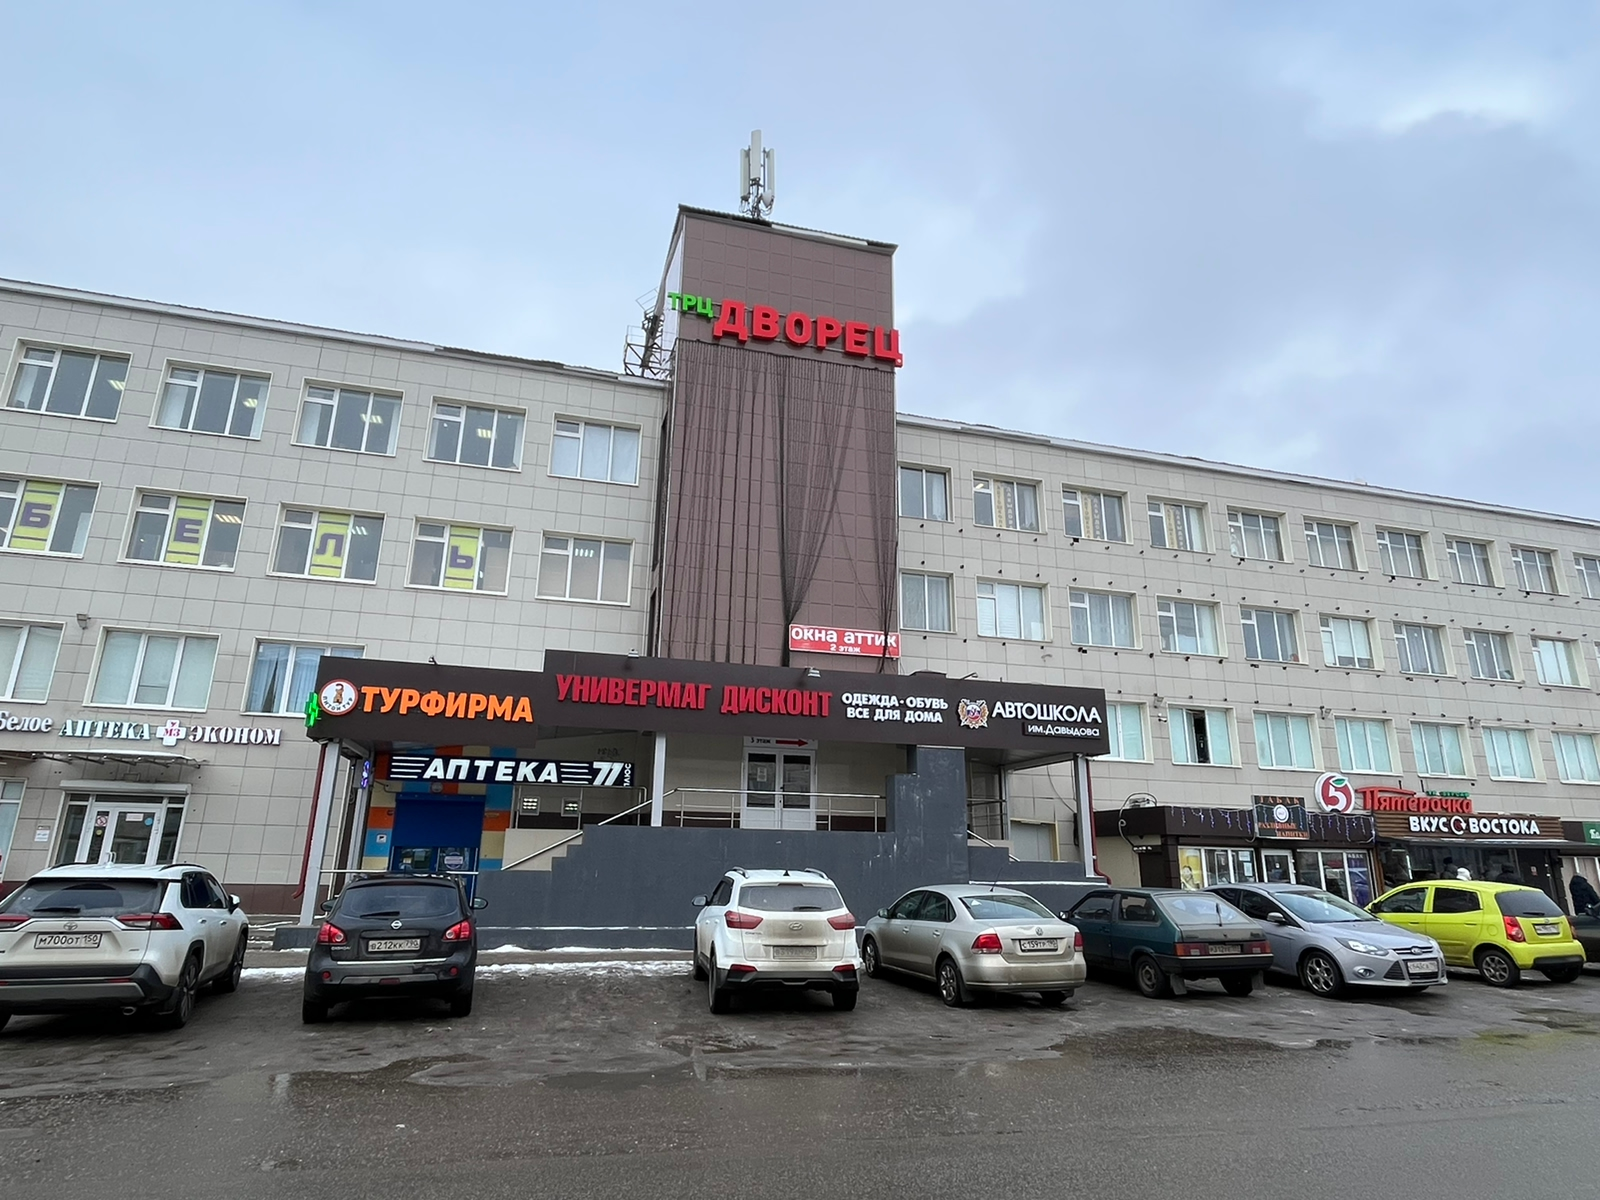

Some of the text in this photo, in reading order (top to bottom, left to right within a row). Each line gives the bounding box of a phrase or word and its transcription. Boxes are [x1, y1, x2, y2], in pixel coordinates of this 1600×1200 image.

[667, 292, 903, 368] ТРЦ ДВОРЕЦ
[360, 685, 534, 723] ТУРФИРМА
[556, 674, 833, 717] УНИВЕРМАГ ДИСКОНТ
[841, 692, 949, 710] ОДЕЖДА ОБУВЬ
[846, 707, 944, 723] ВСЕ ДЛЯ ДОМА
[992, 701, 1102, 723] АВТОШКОЛА
[58, 719, 281, 745] АПТЕКА ЭКОНОМ
[422, 758, 559, 783] АПТЕКА
[1355, 786, 1474, 814] Пятерочка
[1409, 815, 1540, 835] ВКУС ВОСТОКА
